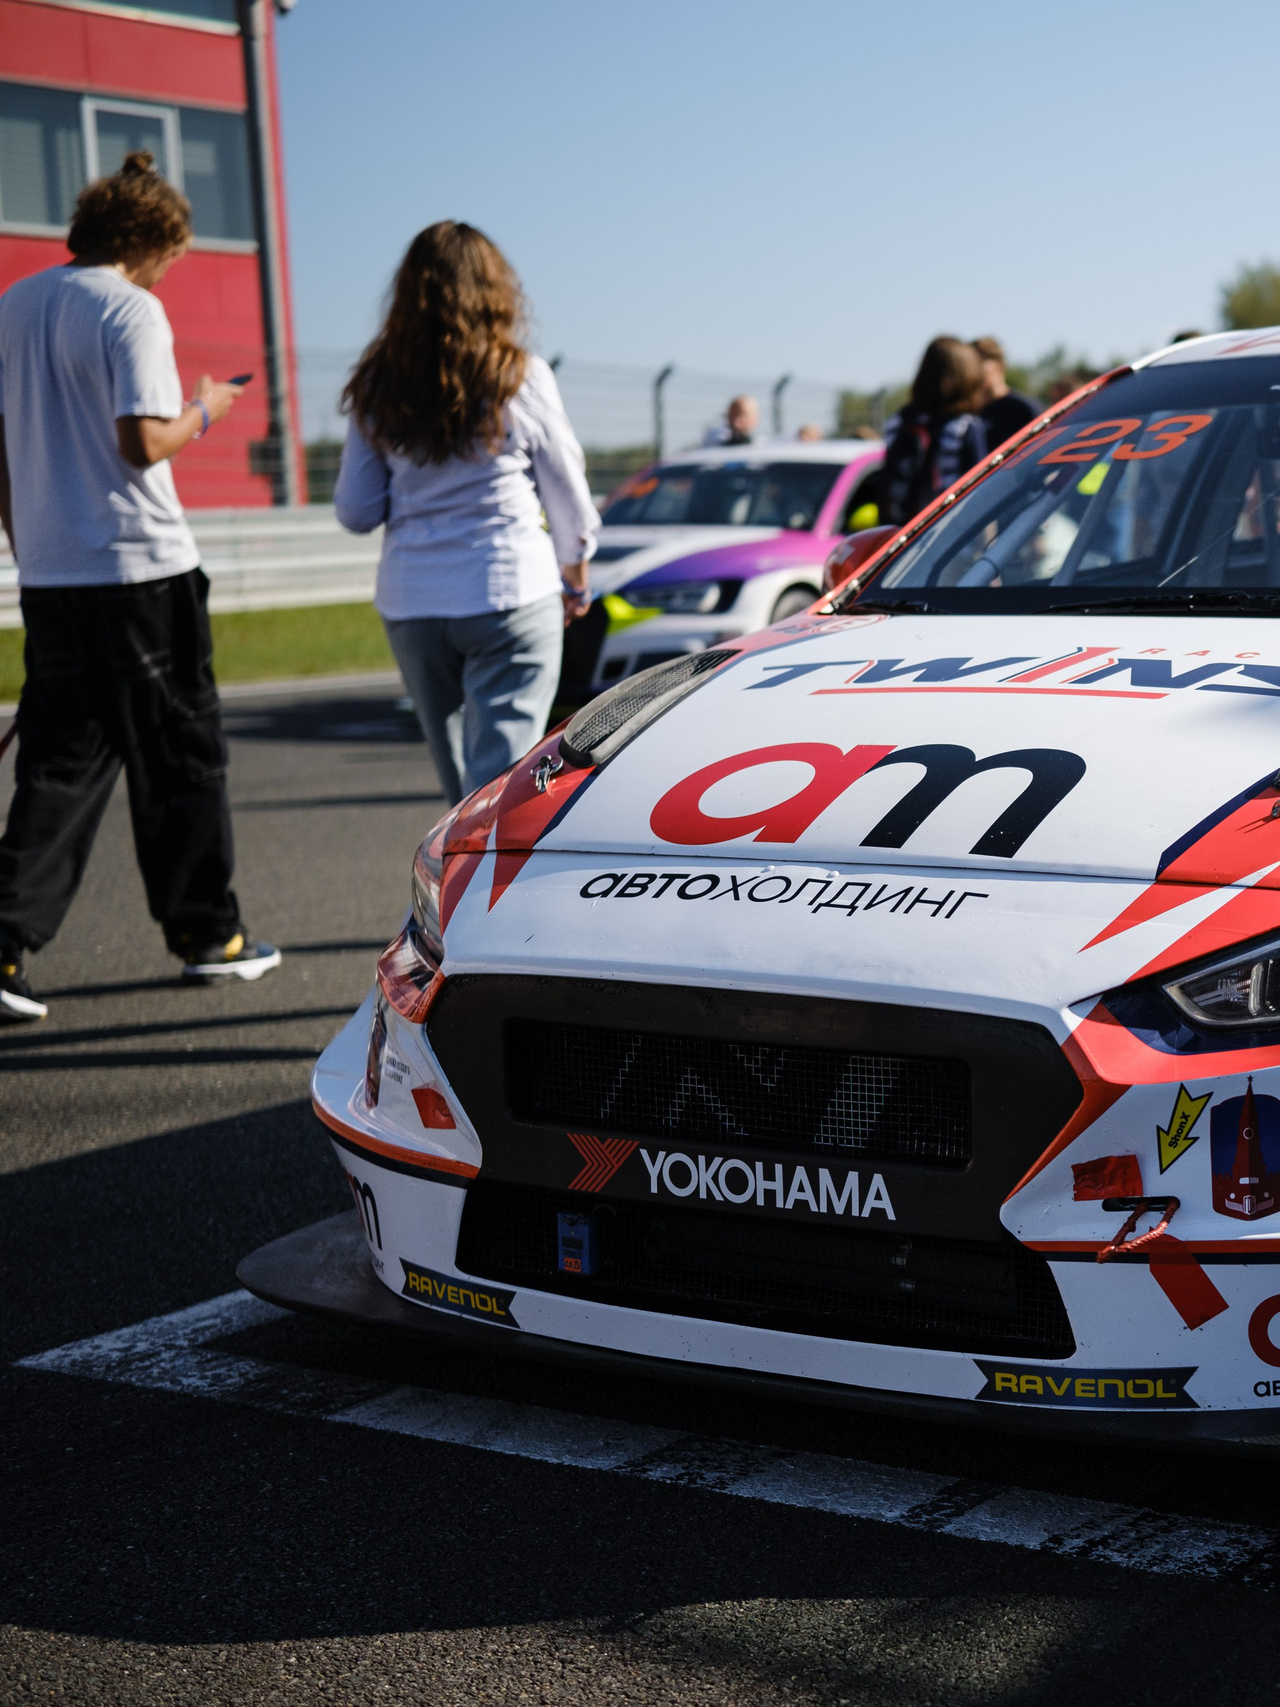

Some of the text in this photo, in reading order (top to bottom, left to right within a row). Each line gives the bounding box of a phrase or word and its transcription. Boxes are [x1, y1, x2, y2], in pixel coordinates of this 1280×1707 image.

[650, 742, 1087, 859] am
[1168, 1111, 1190, 1148] ShonX
[640, 1149, 896, 1221] YOKOHAMA
[408, 1271, 506, 1316] RAVENOL
[995, 1371, 1177, 1399] RAVENOL
